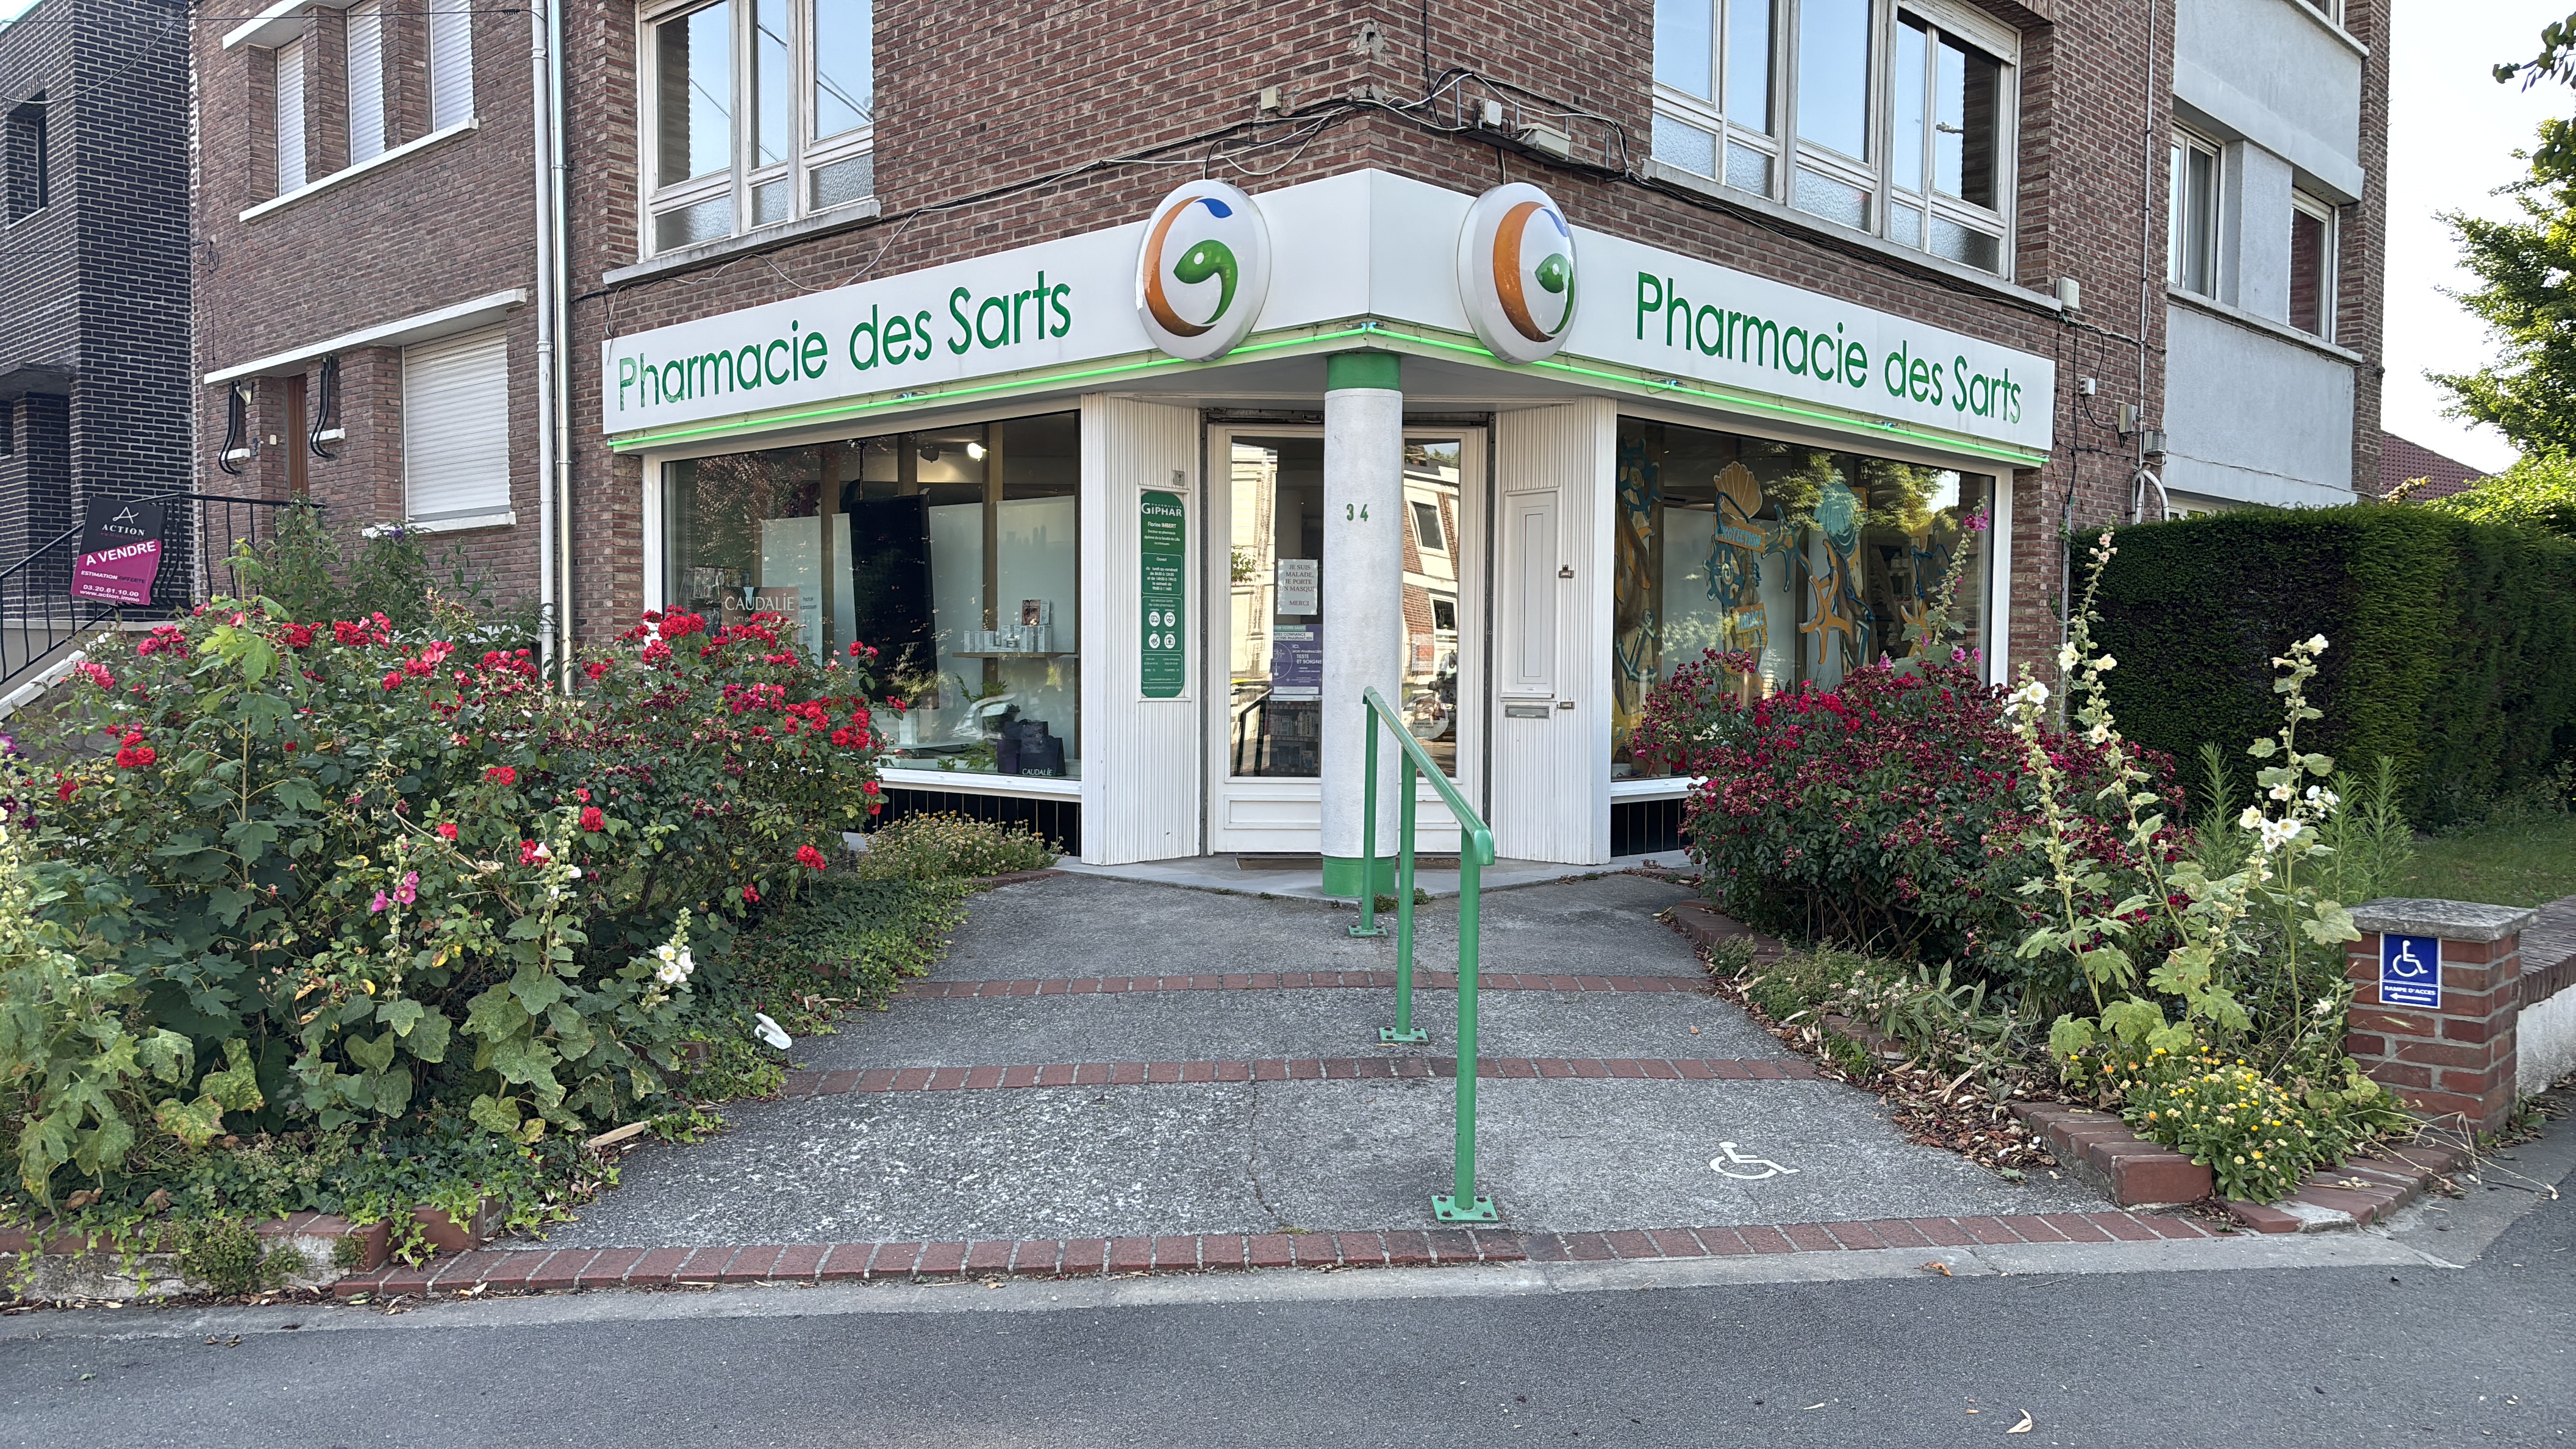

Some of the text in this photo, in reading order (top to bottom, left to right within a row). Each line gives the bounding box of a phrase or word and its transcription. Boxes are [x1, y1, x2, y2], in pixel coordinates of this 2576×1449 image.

[619, 270, 1072, 412] Pharmacie des Sarts
[1636, 271, 2022, 424] Pharmacie des Sarts
[1141, 503, 1182, 517] GIPHAR
[101, 523, 146, 537] ACTION
[1716, 524, 1762, 548] PROTECTION
[86, 541, 157, 567] A VENDRE
[80, 570, 118, 581] ESTIMATION
[79, 590, 140, 603] www.action.immo
[83, 584, 139, 598] 03.20.61.10.00
[1022, 767, 1053, 776] CAUDALÍE
